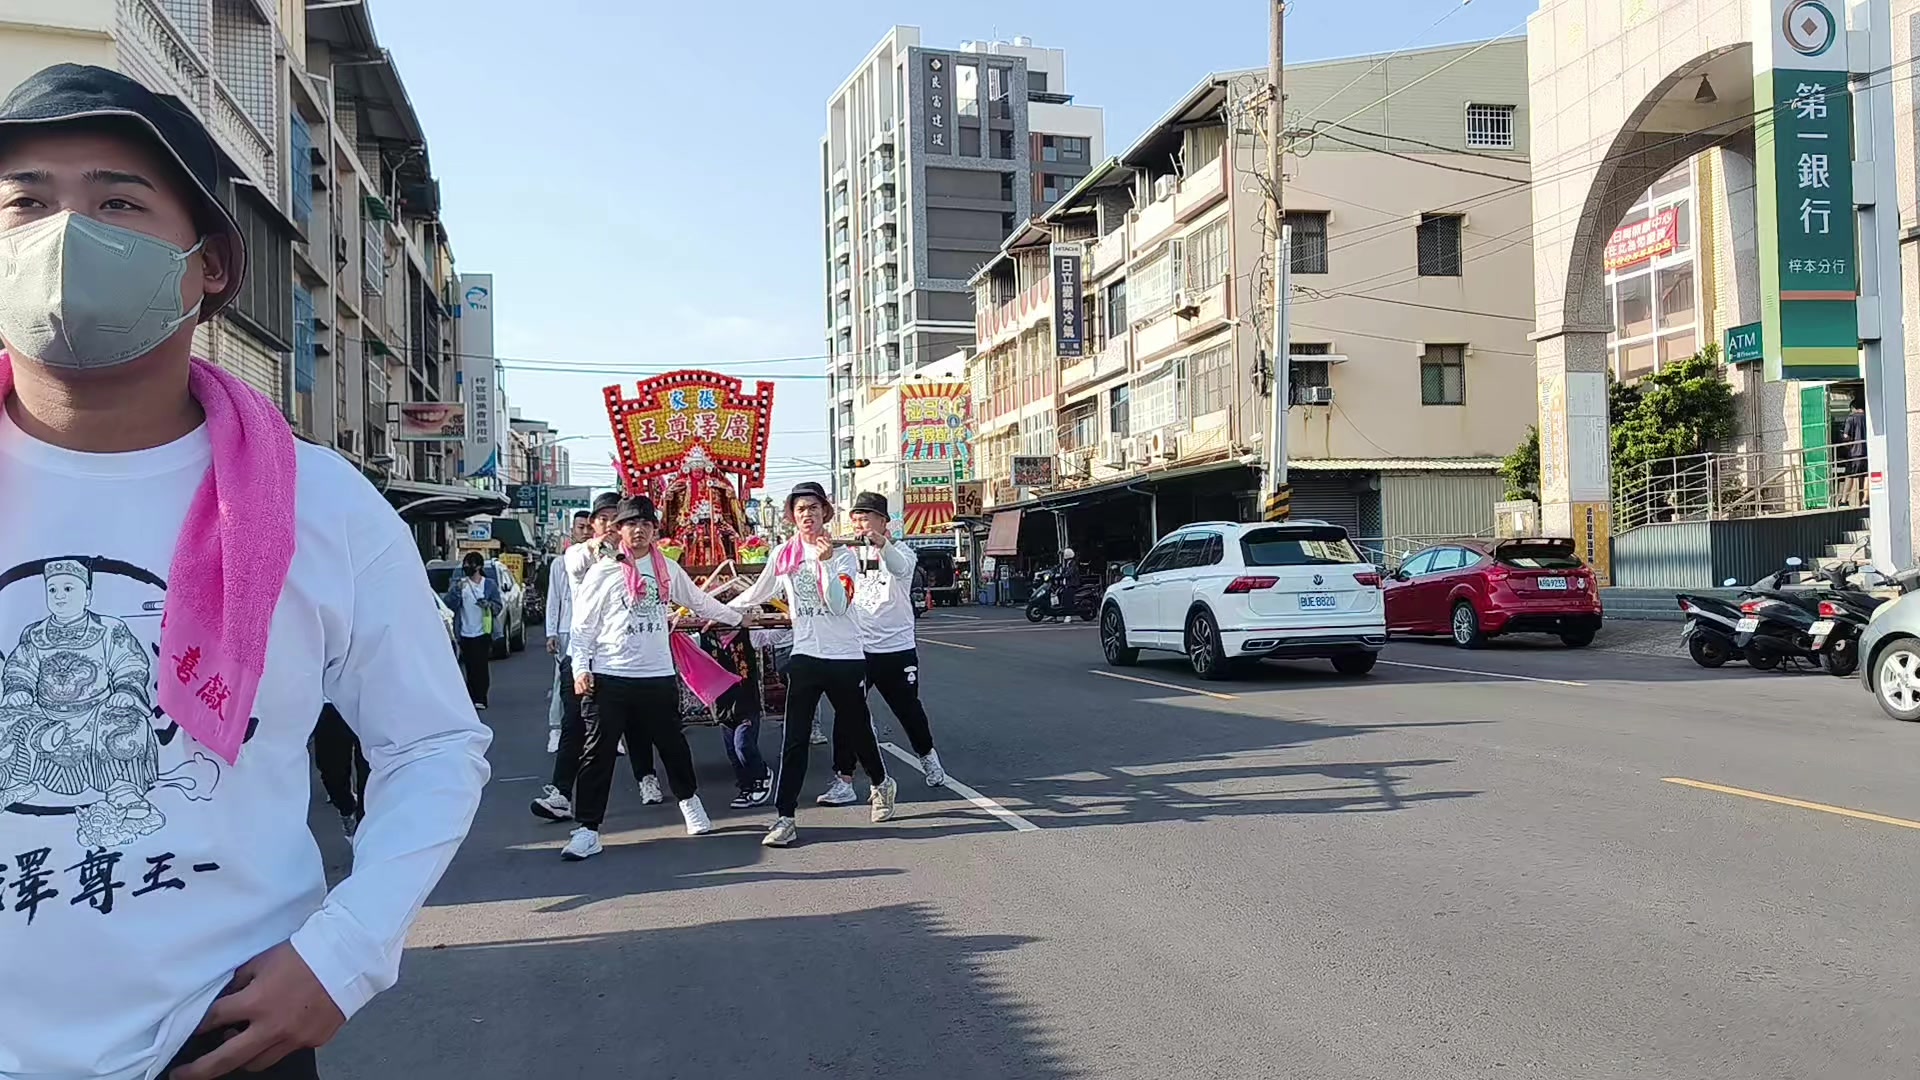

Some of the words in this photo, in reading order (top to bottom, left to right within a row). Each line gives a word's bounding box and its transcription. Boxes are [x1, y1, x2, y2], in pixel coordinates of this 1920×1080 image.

[930, 75, 945, 146] 良富建設
[1795, 82, 1832, 234] 第一銀行
[1612, 211, 1673, 244] 日間照顧中心
[1788, 258, 1846, 274] 梓本分行
[1061, 258, 1075, 338] 日立變頻冷氣
[1729, 331, 1756, 352] ATM
